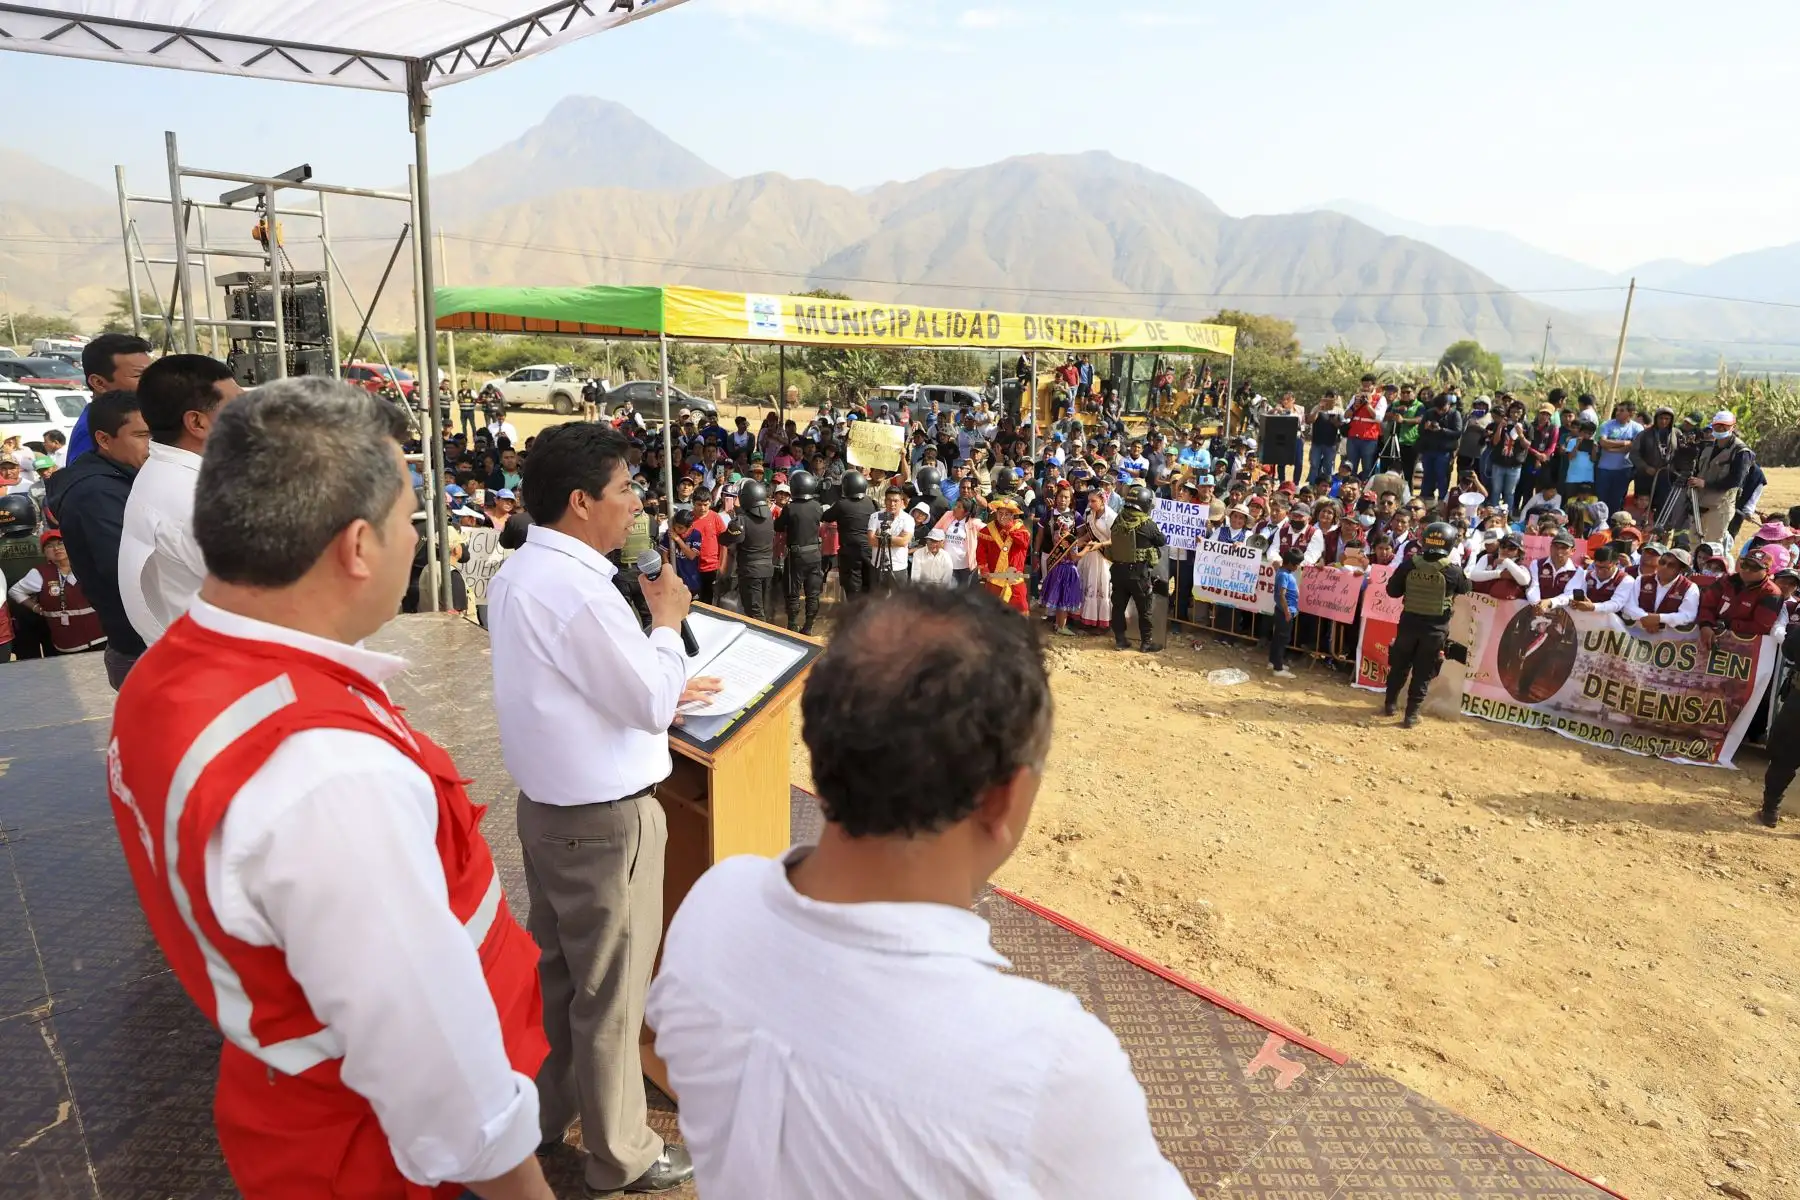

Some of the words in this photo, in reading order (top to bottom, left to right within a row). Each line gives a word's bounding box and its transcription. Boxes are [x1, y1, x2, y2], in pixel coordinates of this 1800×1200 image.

[795, 304, 1000, 339] MUNICIPALIDAD
[1023, 316, 1123, 344] DISTRITAL
[1144, 321, 1169, 342] DE
[1160, 500, 1172, 511] NO
[1175, 502, 1200, 515] MAS
[1156, 521, 1207, 538] ARRETERA
[1203, 540, 1256, 559] EXIGIMOS
[1583, 630, 1697, 671] UNIDOS
[1705, 649, 1752, 681] EN
[1583, 673, 1727, 725] DEFENSA
[1557, 718, 1615, 744] PEDRO
[1101, 983, 1149, 991] BUILD
[1104, 993, 1152, 1001] BUILD
[1107, 1004, 1157, 1012] BUILD
[1110, 1014, 1158, 1023] BUILD
[1113, 1025, 1162, 1034] BUILD
[1167, 1025, 1211, 1033] PLEX
[1171, 1036, 1216, 1044] PLEX
[1175, 1048, 1222, 1057] PLEX
[1180, 1060, 1226, 1069] PLEX
[1184, 1072, 1230, 1082] PLEX
[1189, 1084, 1236, 1095] PLEX
[1342, 1081, 1399, 1093] BUILD
[1193, 1098, 1241, 1109] PLEX
[1197, 1111, 1248, 1123] PLEX
[1305, 1110, 1353, 1122] PLEX
[1357, 1110, 1416, 1122] BUILD
[1202, 1125, 1253, 1137] PLEX
[1308, 1125, 1361, 1137] PLEX
[1365, 1126, 1426, 1137] BUILD
[1317, 1141, 1368, 1154] PLEX
[1373, 1141, 1435, 1154] BUILD
[1446, 1142, 1500, 1155] PLEX
[1327, 1158, 1380, 1170] PLEX
[1382, 1158, 1445, 1170] BUILD
[1459, 1158, 1511, 1171] PLEX
[1257, 1173, 1321, 1187] BUILD
[1333, 1174, 1388, 1187] PLEX
[1391, 1174, 1456, 1188] BUILD
[1467, 1175, 1522, 1189] PLEX
